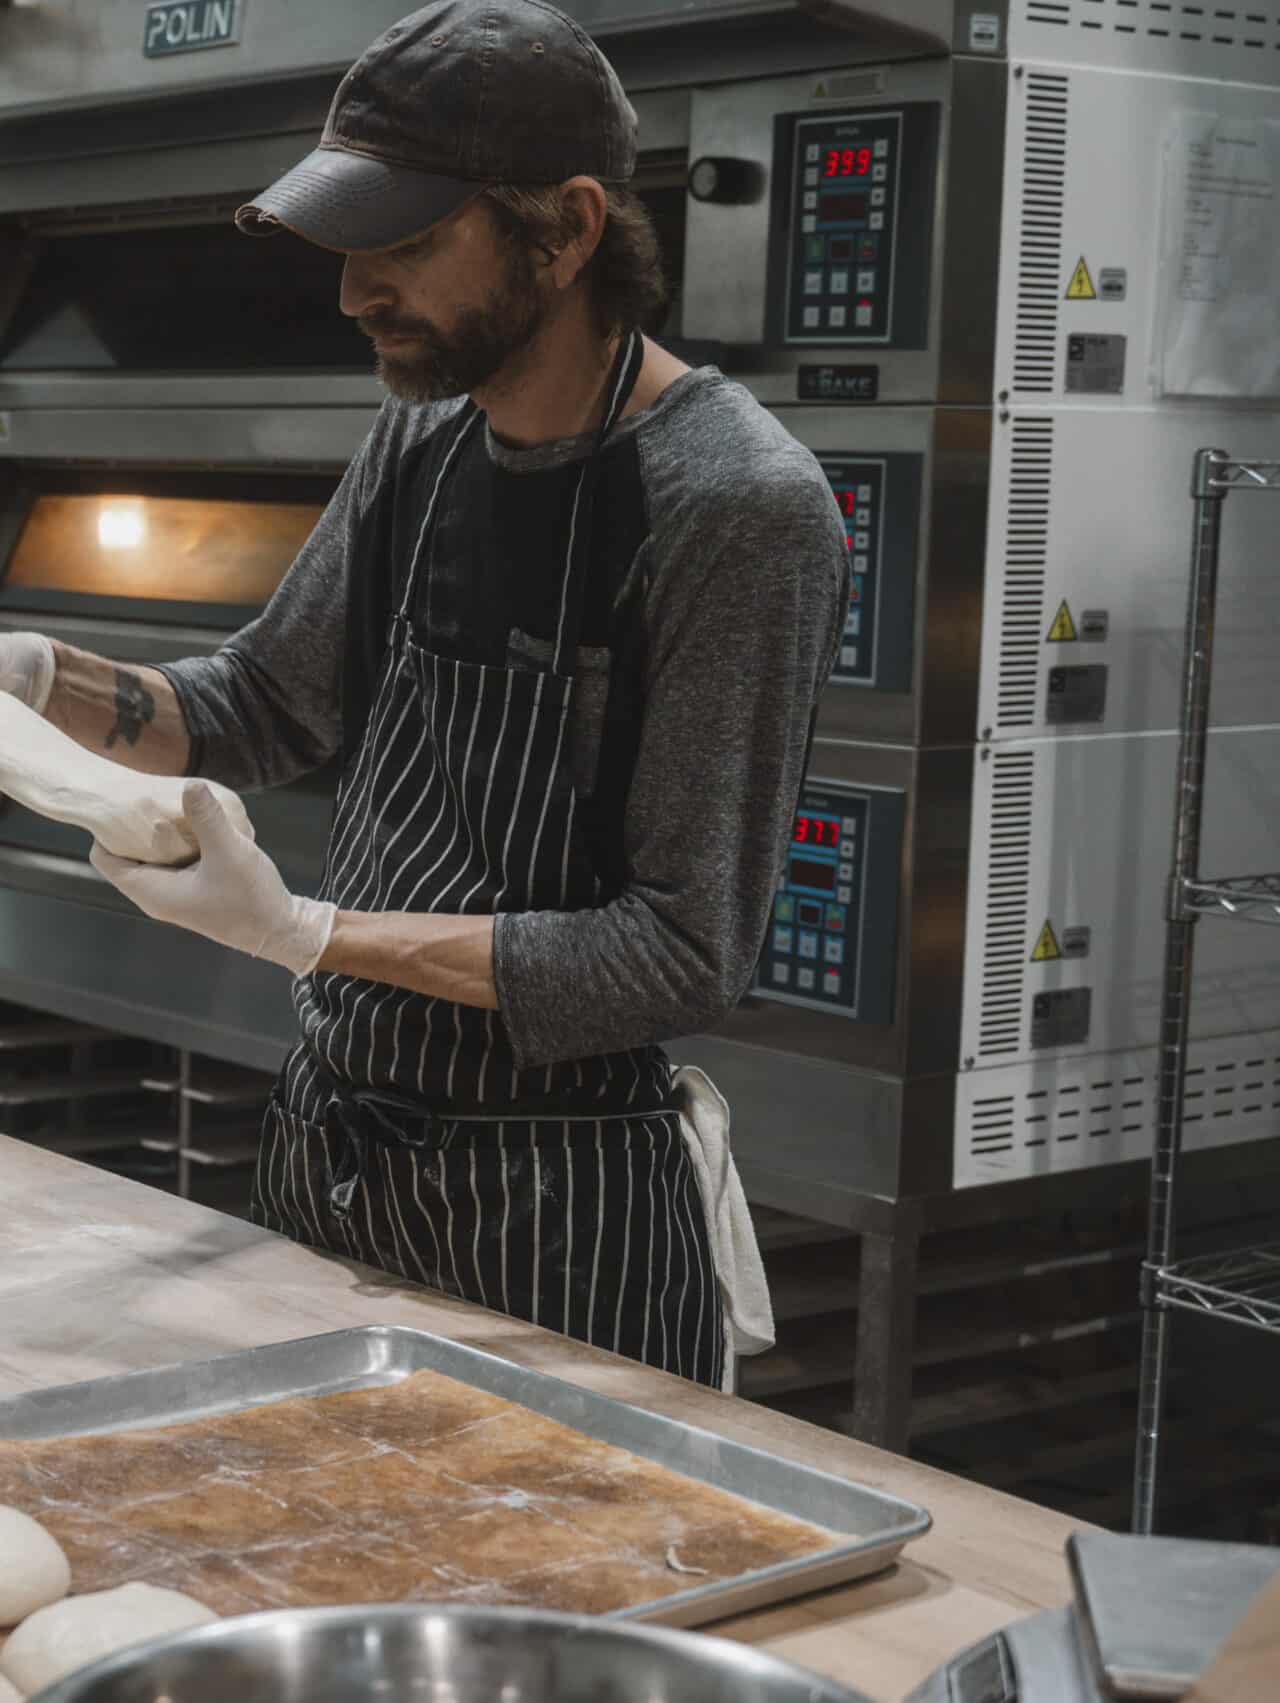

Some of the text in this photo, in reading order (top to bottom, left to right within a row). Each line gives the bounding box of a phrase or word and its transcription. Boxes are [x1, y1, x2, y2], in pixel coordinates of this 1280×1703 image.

[147, 0, 231, 48] POLIN
[824, 148, 871, 177] 399
[794, 817, 840, 848] 377
